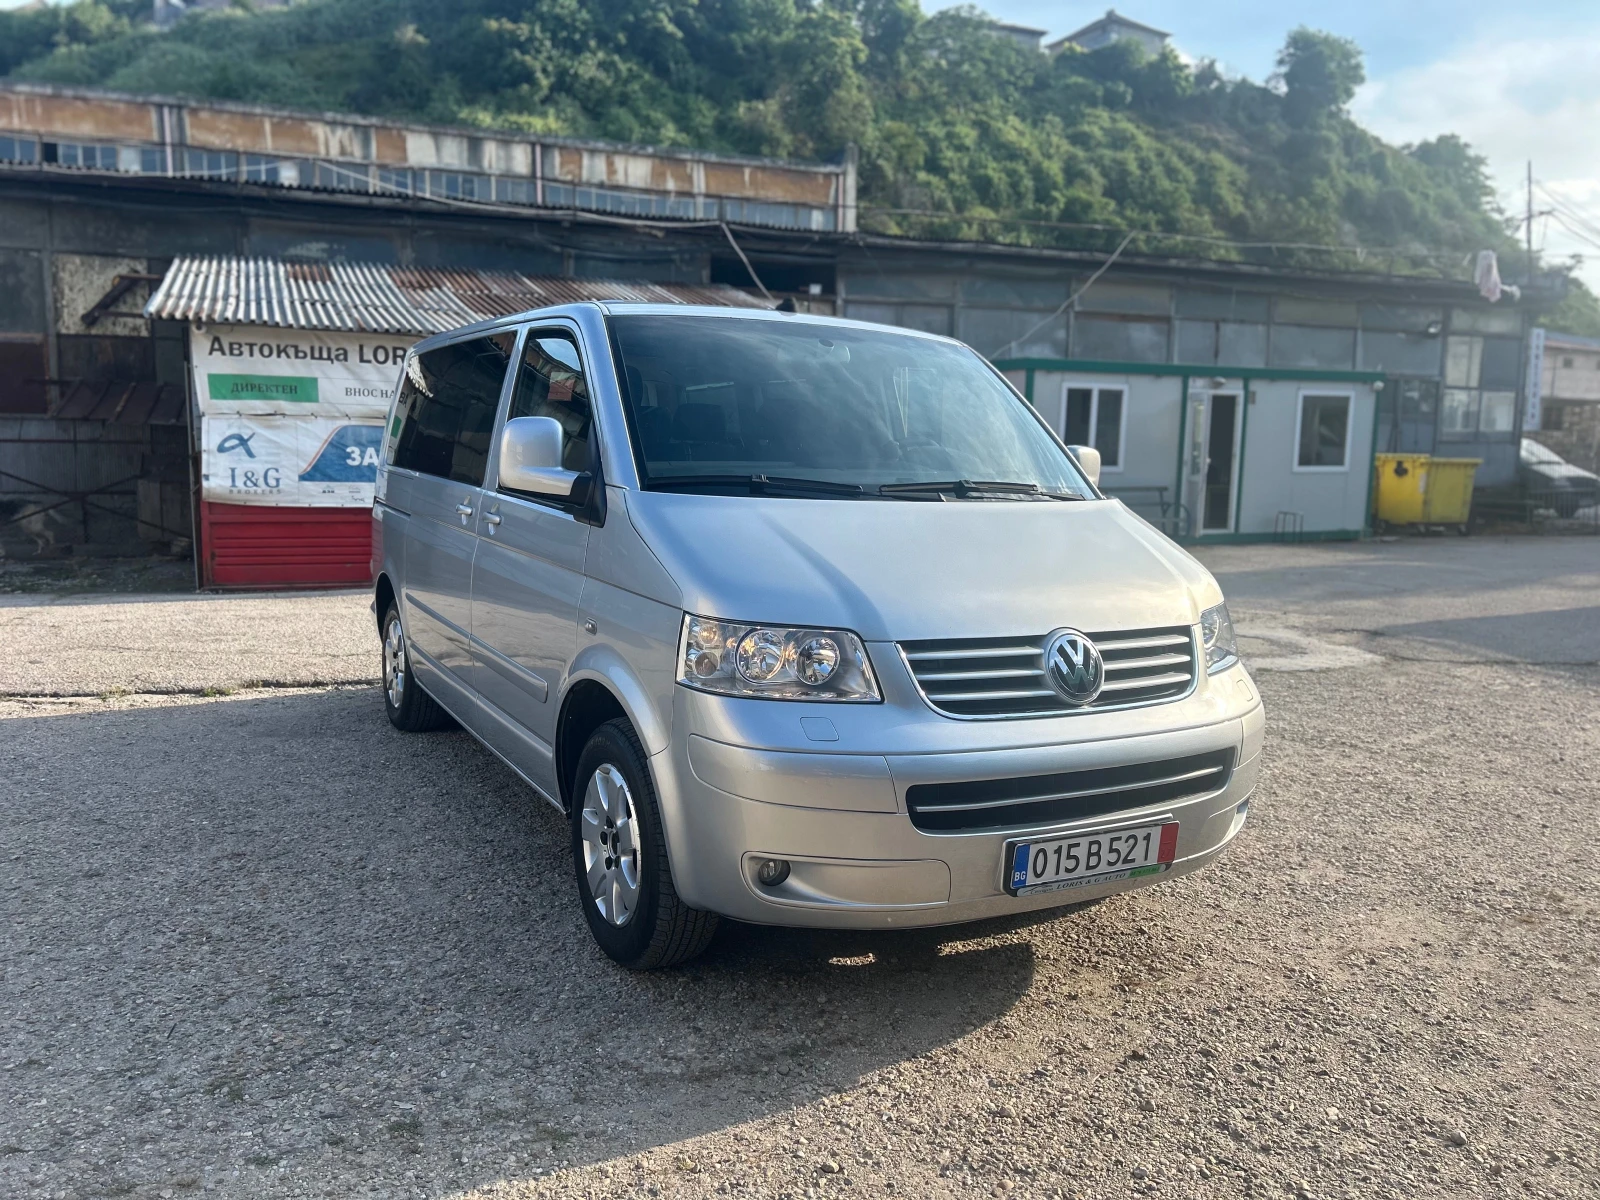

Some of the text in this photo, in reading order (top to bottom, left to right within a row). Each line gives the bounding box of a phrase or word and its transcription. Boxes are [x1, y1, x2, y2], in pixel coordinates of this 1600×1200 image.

[208, 336, 348, 364] Автокъща
[231, 382, 298, 395] ДИРЕКТЕН
[345, 387, 378, 398] ВНОС
[1014, 871, 1026, 882] BG
[1056, 880, 1084, 890] LORIS
[1104, 872, 1126, 881] AUTO
